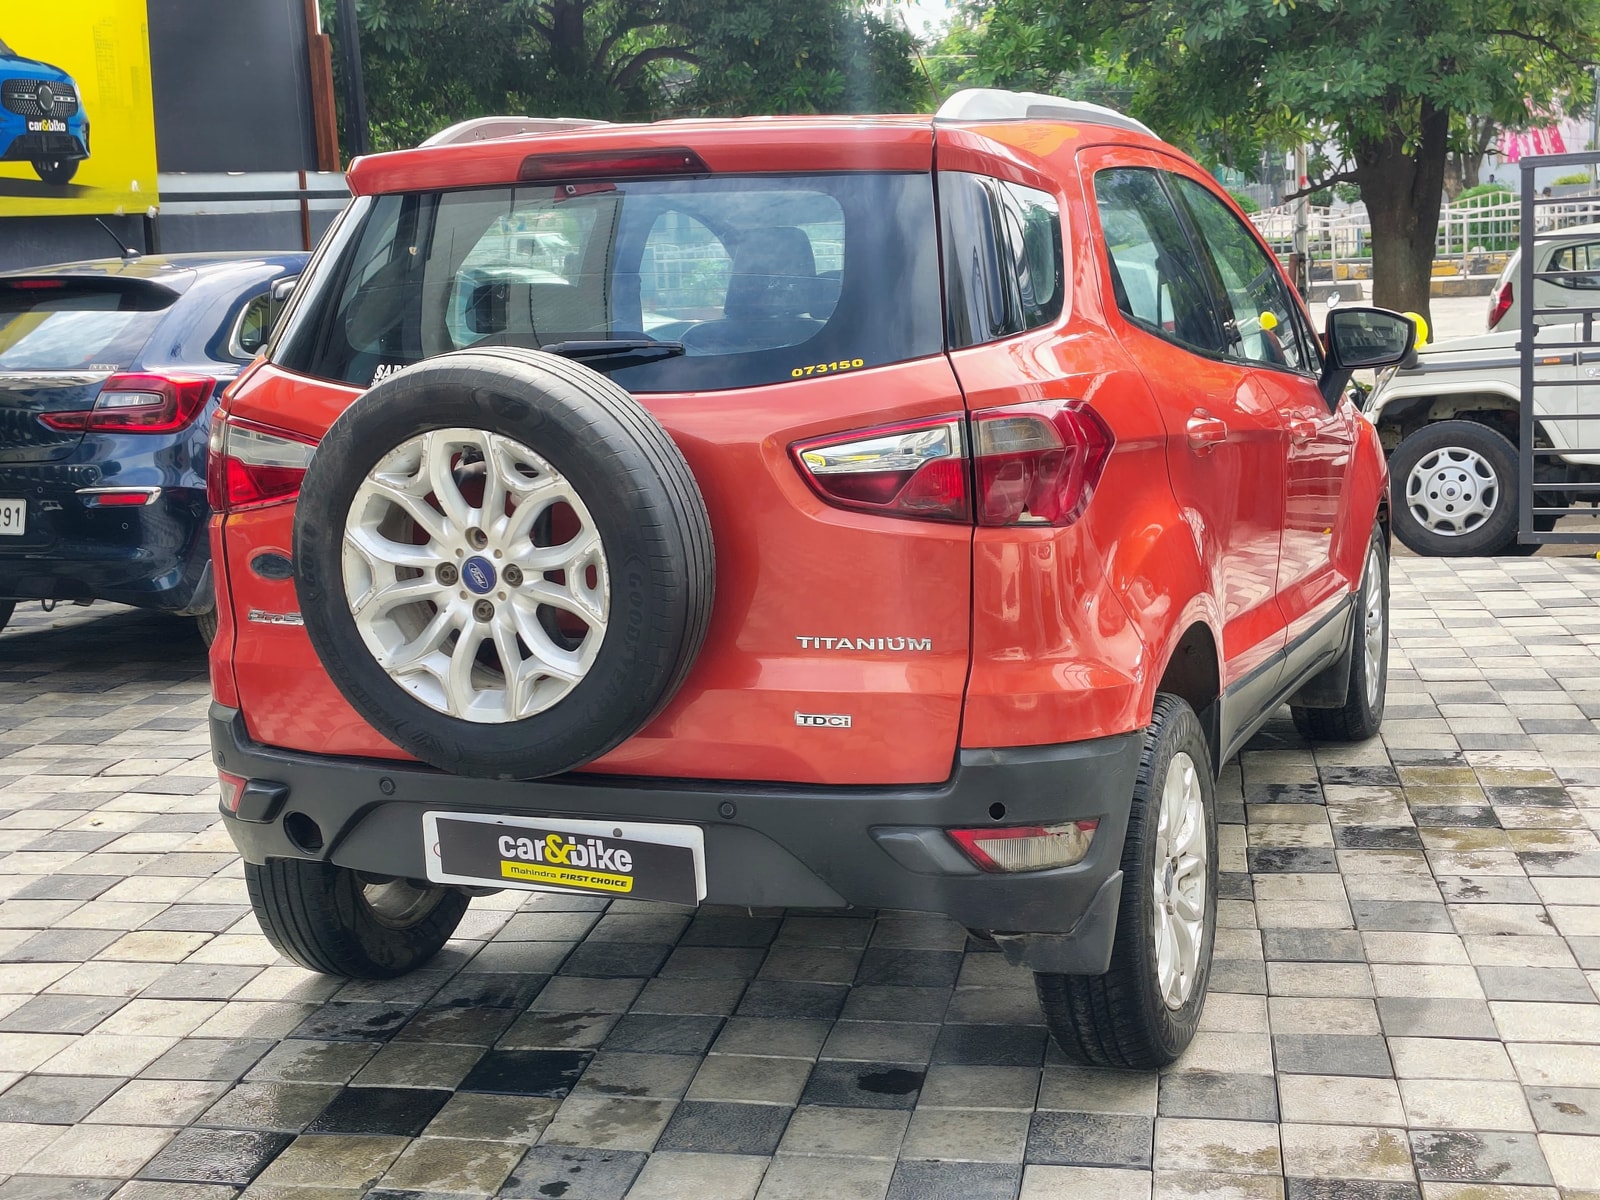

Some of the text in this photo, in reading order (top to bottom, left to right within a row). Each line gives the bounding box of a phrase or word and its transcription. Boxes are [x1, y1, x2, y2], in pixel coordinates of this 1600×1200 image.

[28, 119, 66, 131] car&bike
[791, 358, 864, 377] 073150
[0, 506, 20, 527] 91
[796, 636, 932, 651] TITANIUM
[799, 715, 850, 727] TDCi
[498, 834, 633, 873] car&bike
[510, 866, 628, 887] Mahindra FIRST CHOICE
